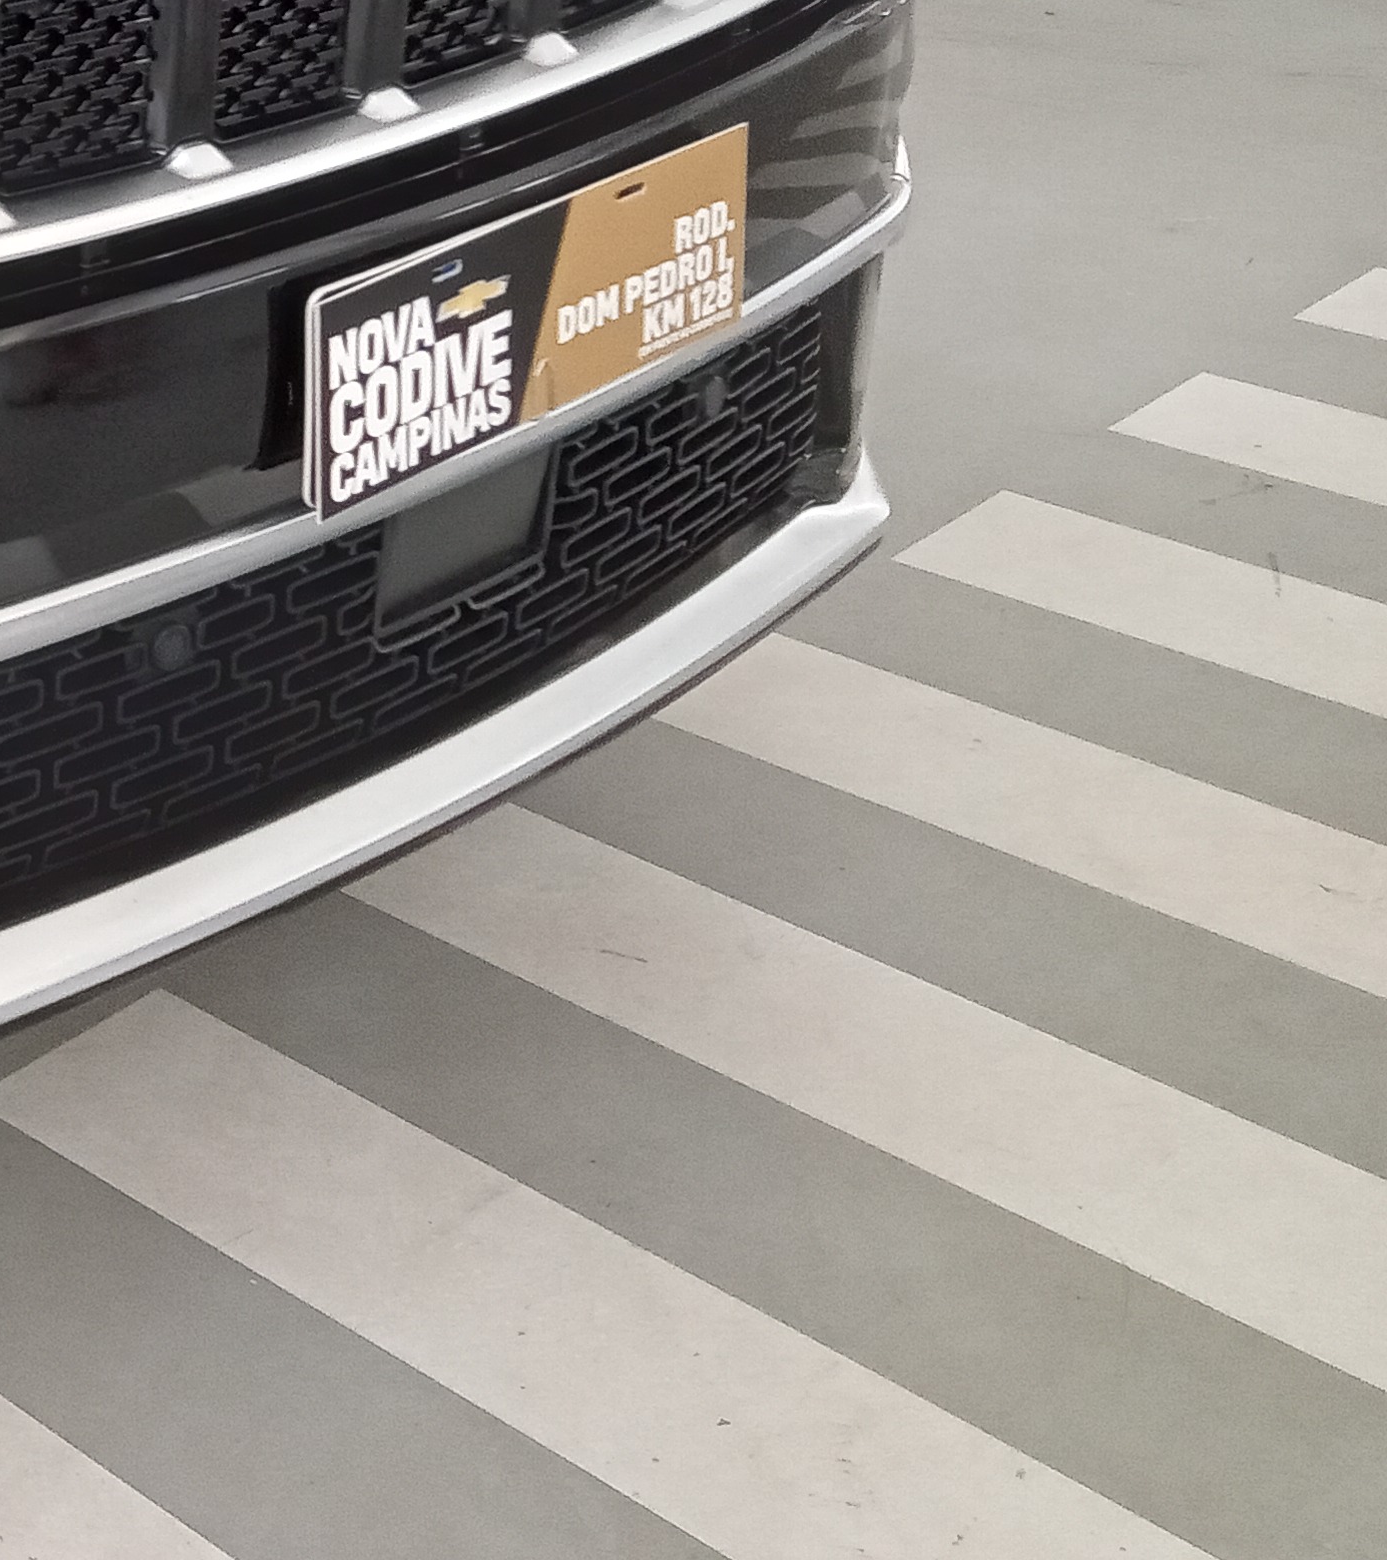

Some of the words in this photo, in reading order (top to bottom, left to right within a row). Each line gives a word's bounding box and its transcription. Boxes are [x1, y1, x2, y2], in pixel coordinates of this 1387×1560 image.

[674, 200, 736, 254] ROD.
[328, 296, 436, 390] NOVA
[556, 284, 620, 345] DOM
[624, 244, 714, 315] PEDRO
[642, 293, 686, 344] KM
[690, 272, 734, 321] 128
[329, 309, 514, 454] CODIVE
[330, 379, 513, 503] CAMPINAS
